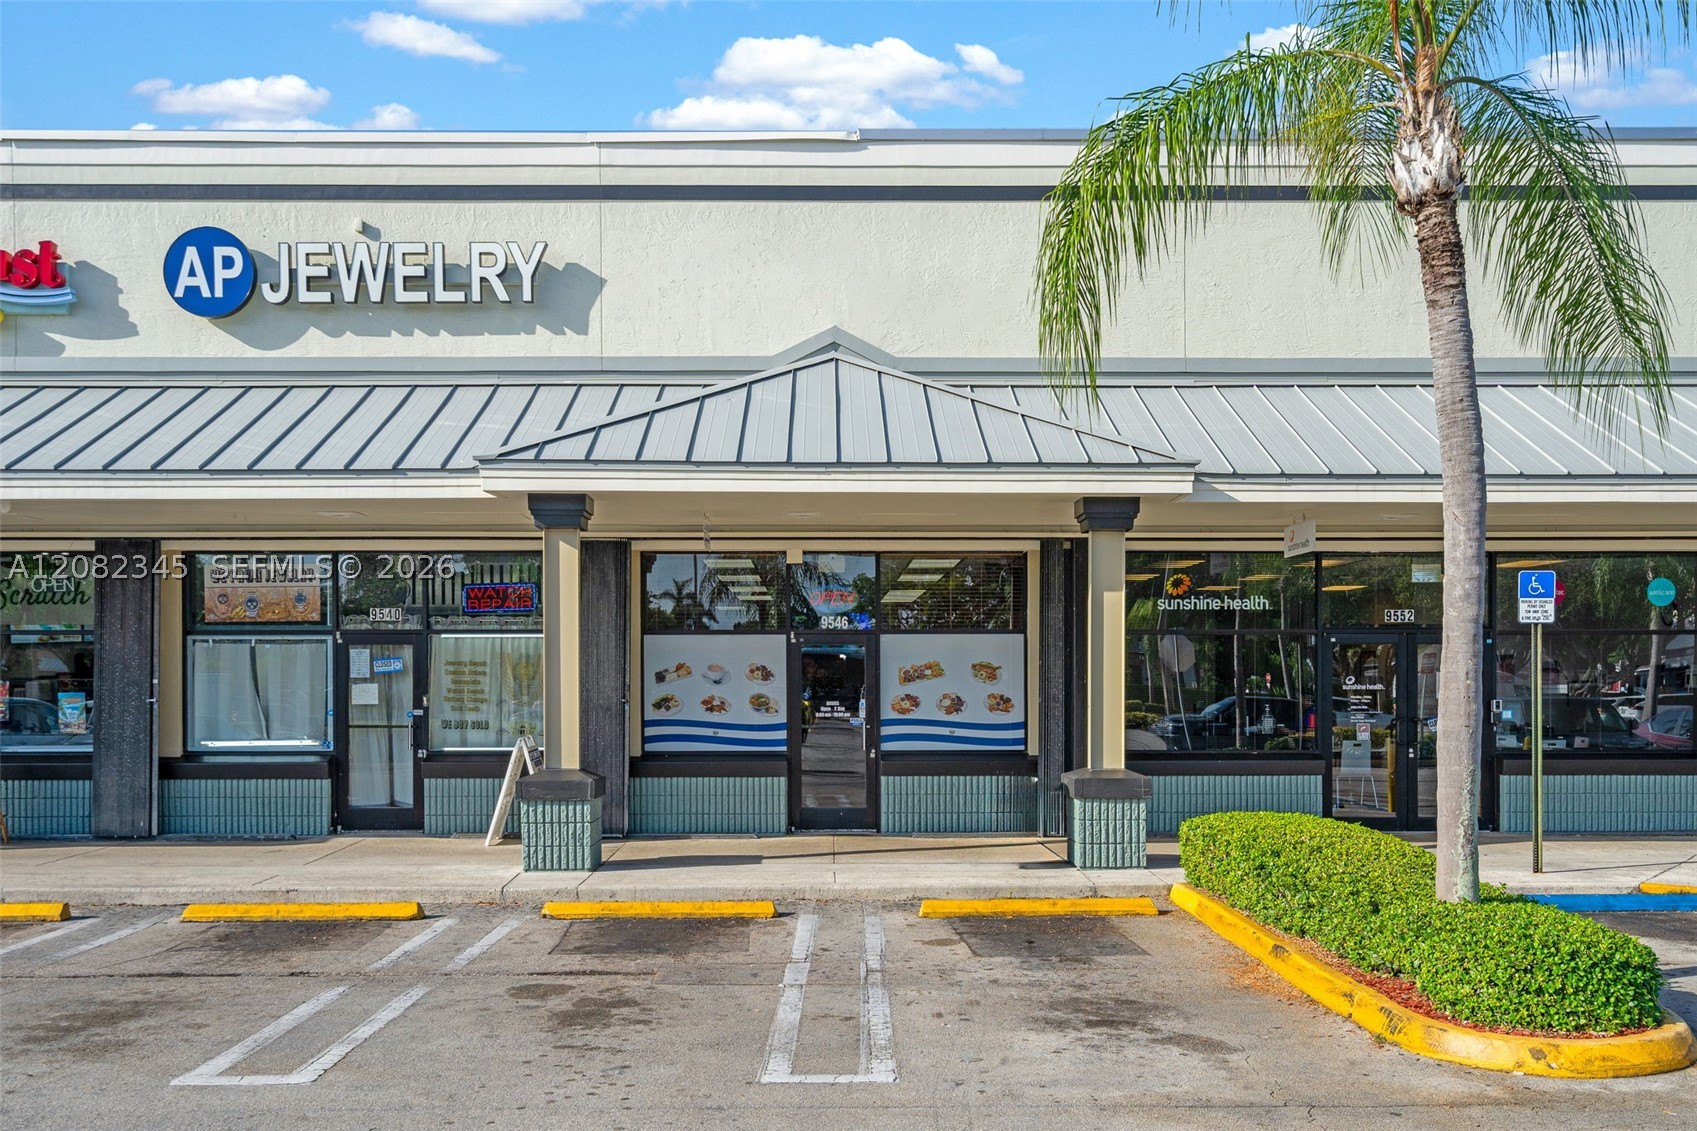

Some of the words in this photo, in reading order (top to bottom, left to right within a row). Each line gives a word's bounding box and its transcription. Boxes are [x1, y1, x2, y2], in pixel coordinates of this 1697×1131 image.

[174, 246, 244, 298] AP
[261, 241, 548, 304] JEWELRY
[31, 576, 75, 593] OPEN
[468, 587, 532, 599] WATCH
[810, 590, 856, 606] OPEN
[467, 597, 532, 610] REPAIR
[1157, 595, 1221, 610] sunshine
[1224, 595, 1269, 610] health
[371, 608, 400, 620] 9540
[1385, 610, 1414, 622] 9552
[821, 616, 848, 629] 9546
[374, 660, 393, 668] CLOSED
[453, 720, 469, 730] BUY
[470, 720, 490, 730] GOLD
